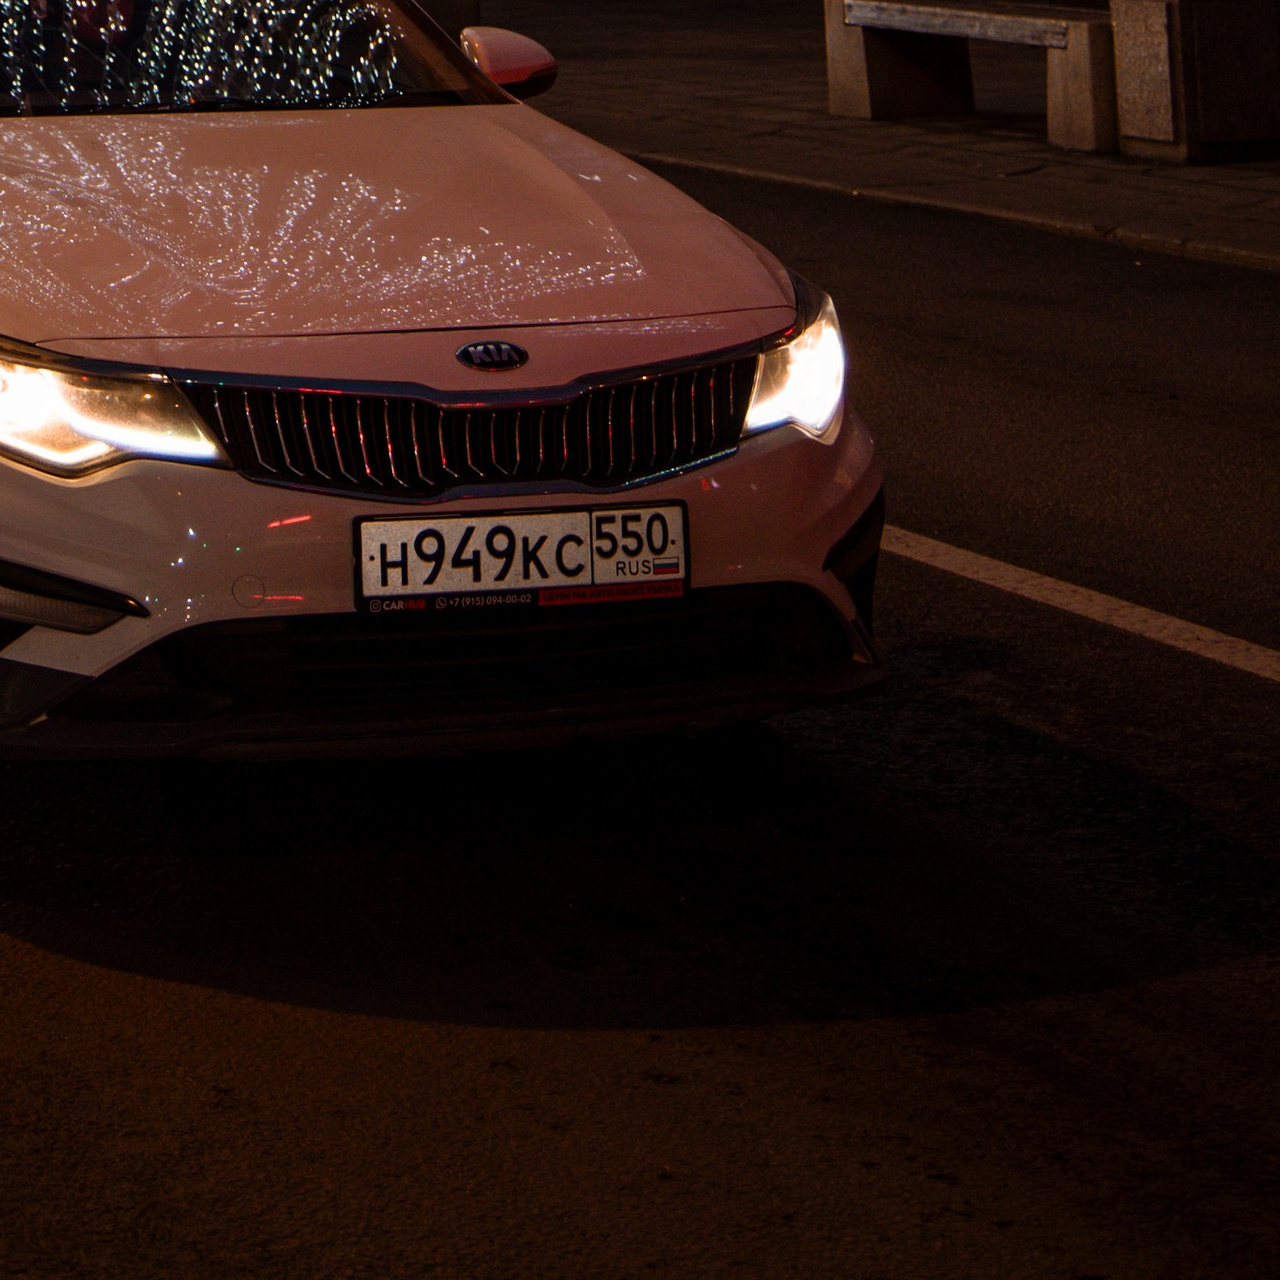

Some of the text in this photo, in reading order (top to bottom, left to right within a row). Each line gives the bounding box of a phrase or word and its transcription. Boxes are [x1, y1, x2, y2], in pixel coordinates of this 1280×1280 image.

[468, 344, 519, 364] KIA
[595, 513, 669, 557] 550
[616, 558, 651, 577] RUS
